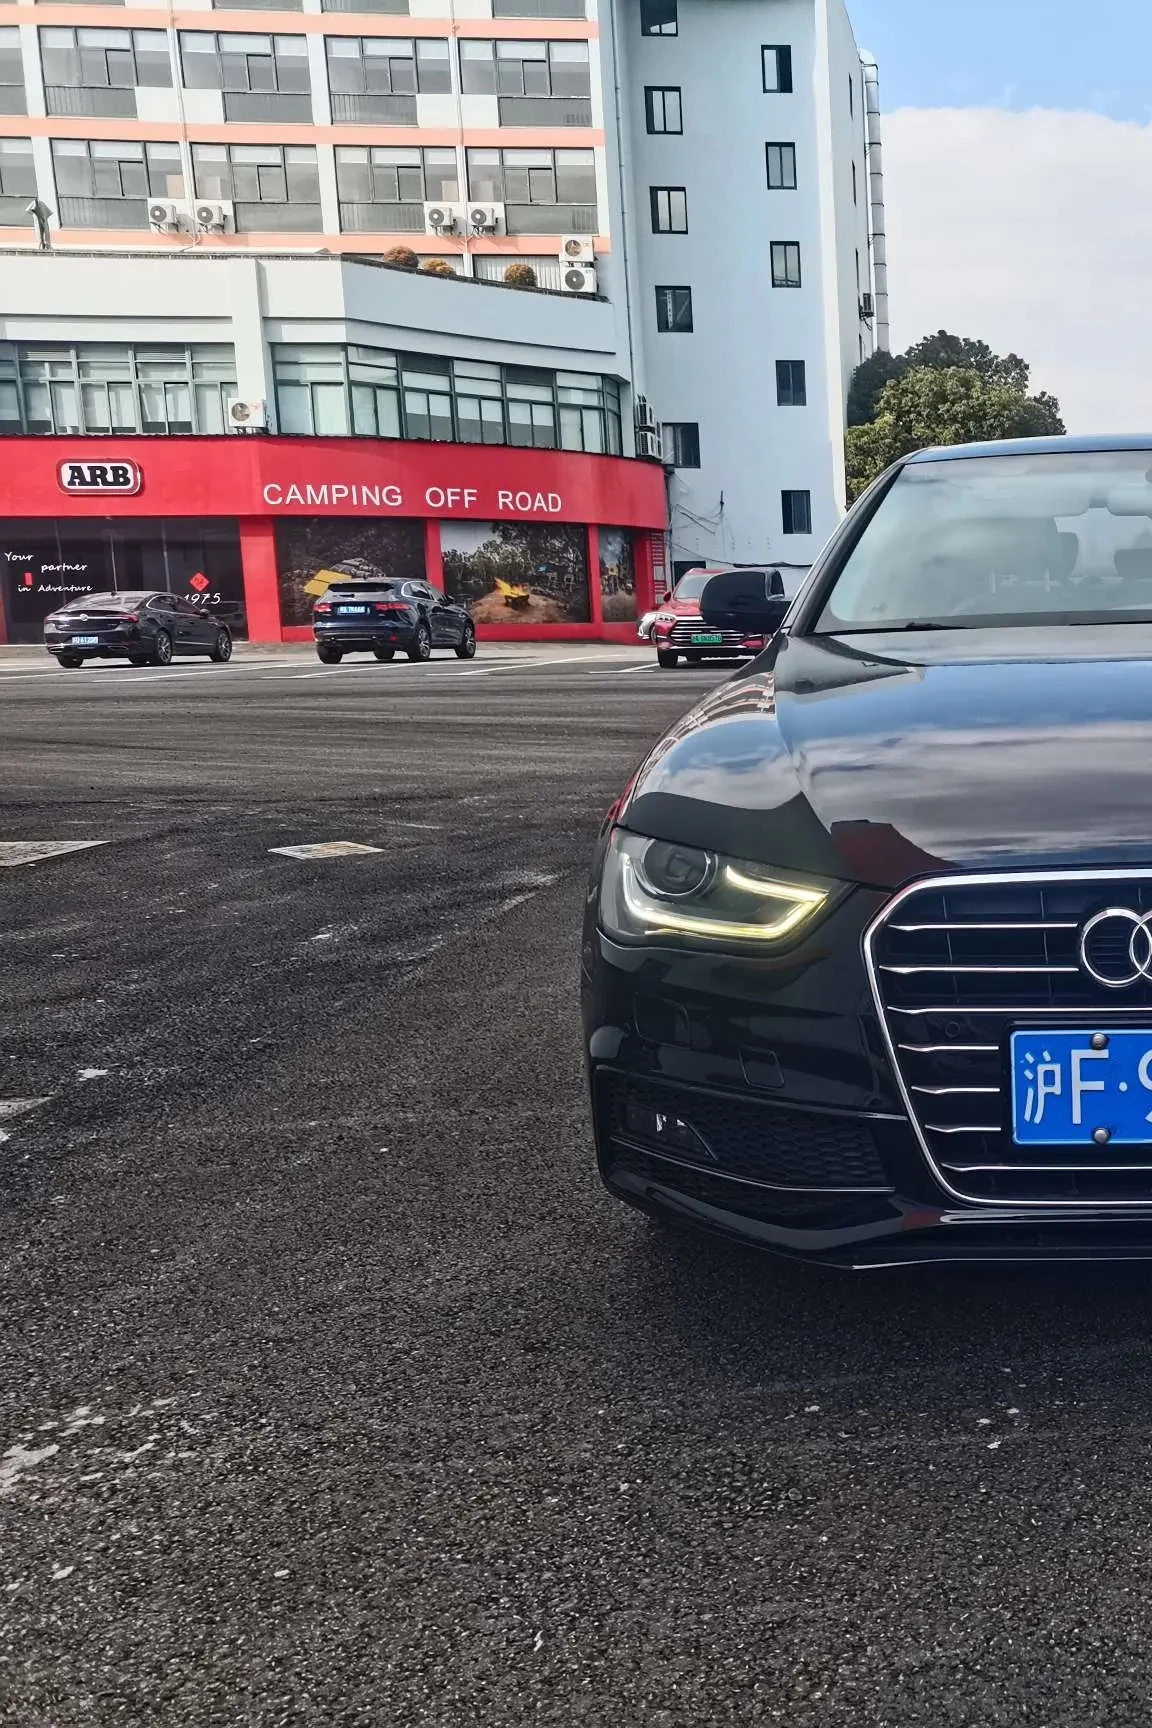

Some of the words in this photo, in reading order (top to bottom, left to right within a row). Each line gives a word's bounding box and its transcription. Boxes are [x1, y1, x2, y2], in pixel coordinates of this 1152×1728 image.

[67, 465, 131, 487] ARB
[262, 483, 402, 507] CAMPING
[425, 486, 478, 509] OFF
[497, 490, 562, 513] ROAD
[4, 551, 34, 562] Your
[41, 562, 88, 573] partner
[18, 584, 31, 592] in
[38, 584, 93, 592] Adventure
